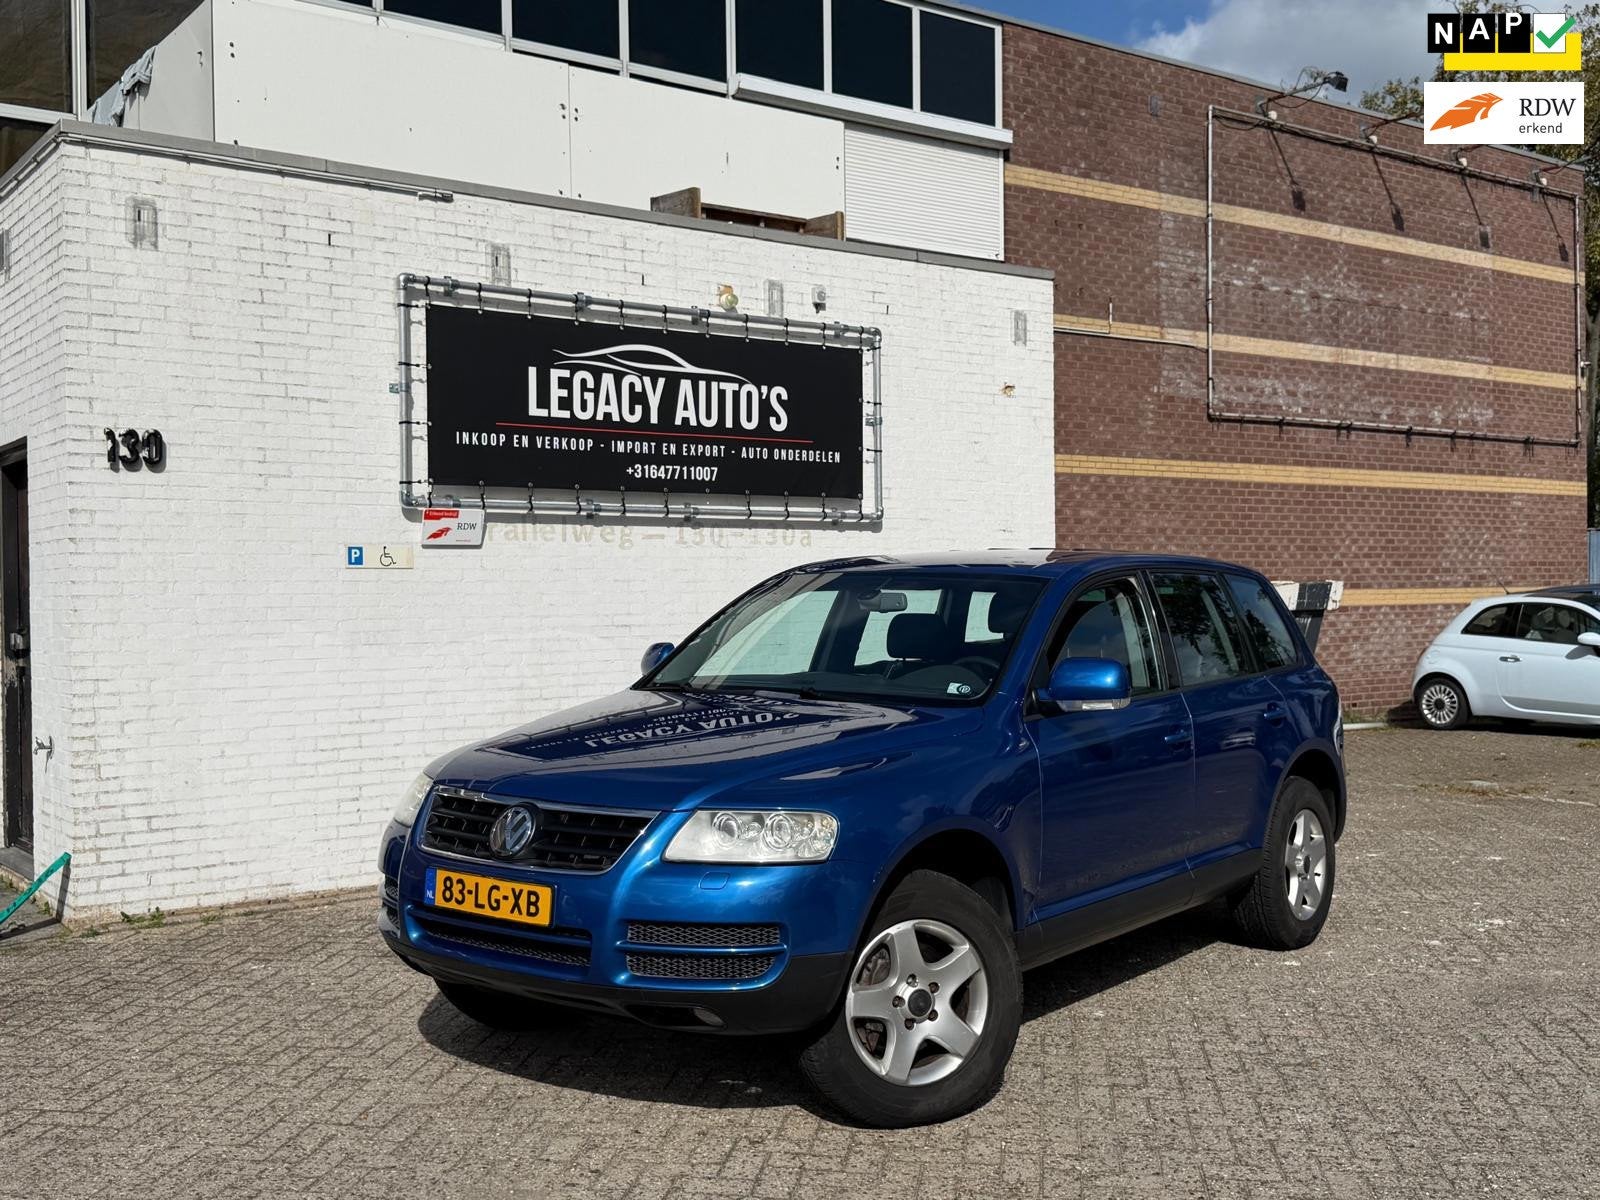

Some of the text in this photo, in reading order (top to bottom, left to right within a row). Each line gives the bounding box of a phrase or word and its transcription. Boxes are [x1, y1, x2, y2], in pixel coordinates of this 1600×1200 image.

[528, 366, 788, 432] LEGACY AUTO'S
[104, 427, 163, 465] 130
[456, 431, 506, 447] INKOOP
[513, 434, 529, 448] EN
[536, 435, 594, 451] VERKOOP
[611, 440, 656, 454] IMPORT
[662, 442, 677, 455] EN
[682, 443, 726, 458] EXPORT
[741, 447, 768, 459] AUTO
[773, 448, 841, 464] ONDERDELEN
[626, 464, 718, 482] +31647711007
[456, 522, 478, 531] RDW
[486, 514, 634, 550] rallelweg
[351, 548, 360, 563] P
[426, 889, 435, 900] NL
[441, 875, 540, 918] 83-LG-XB
